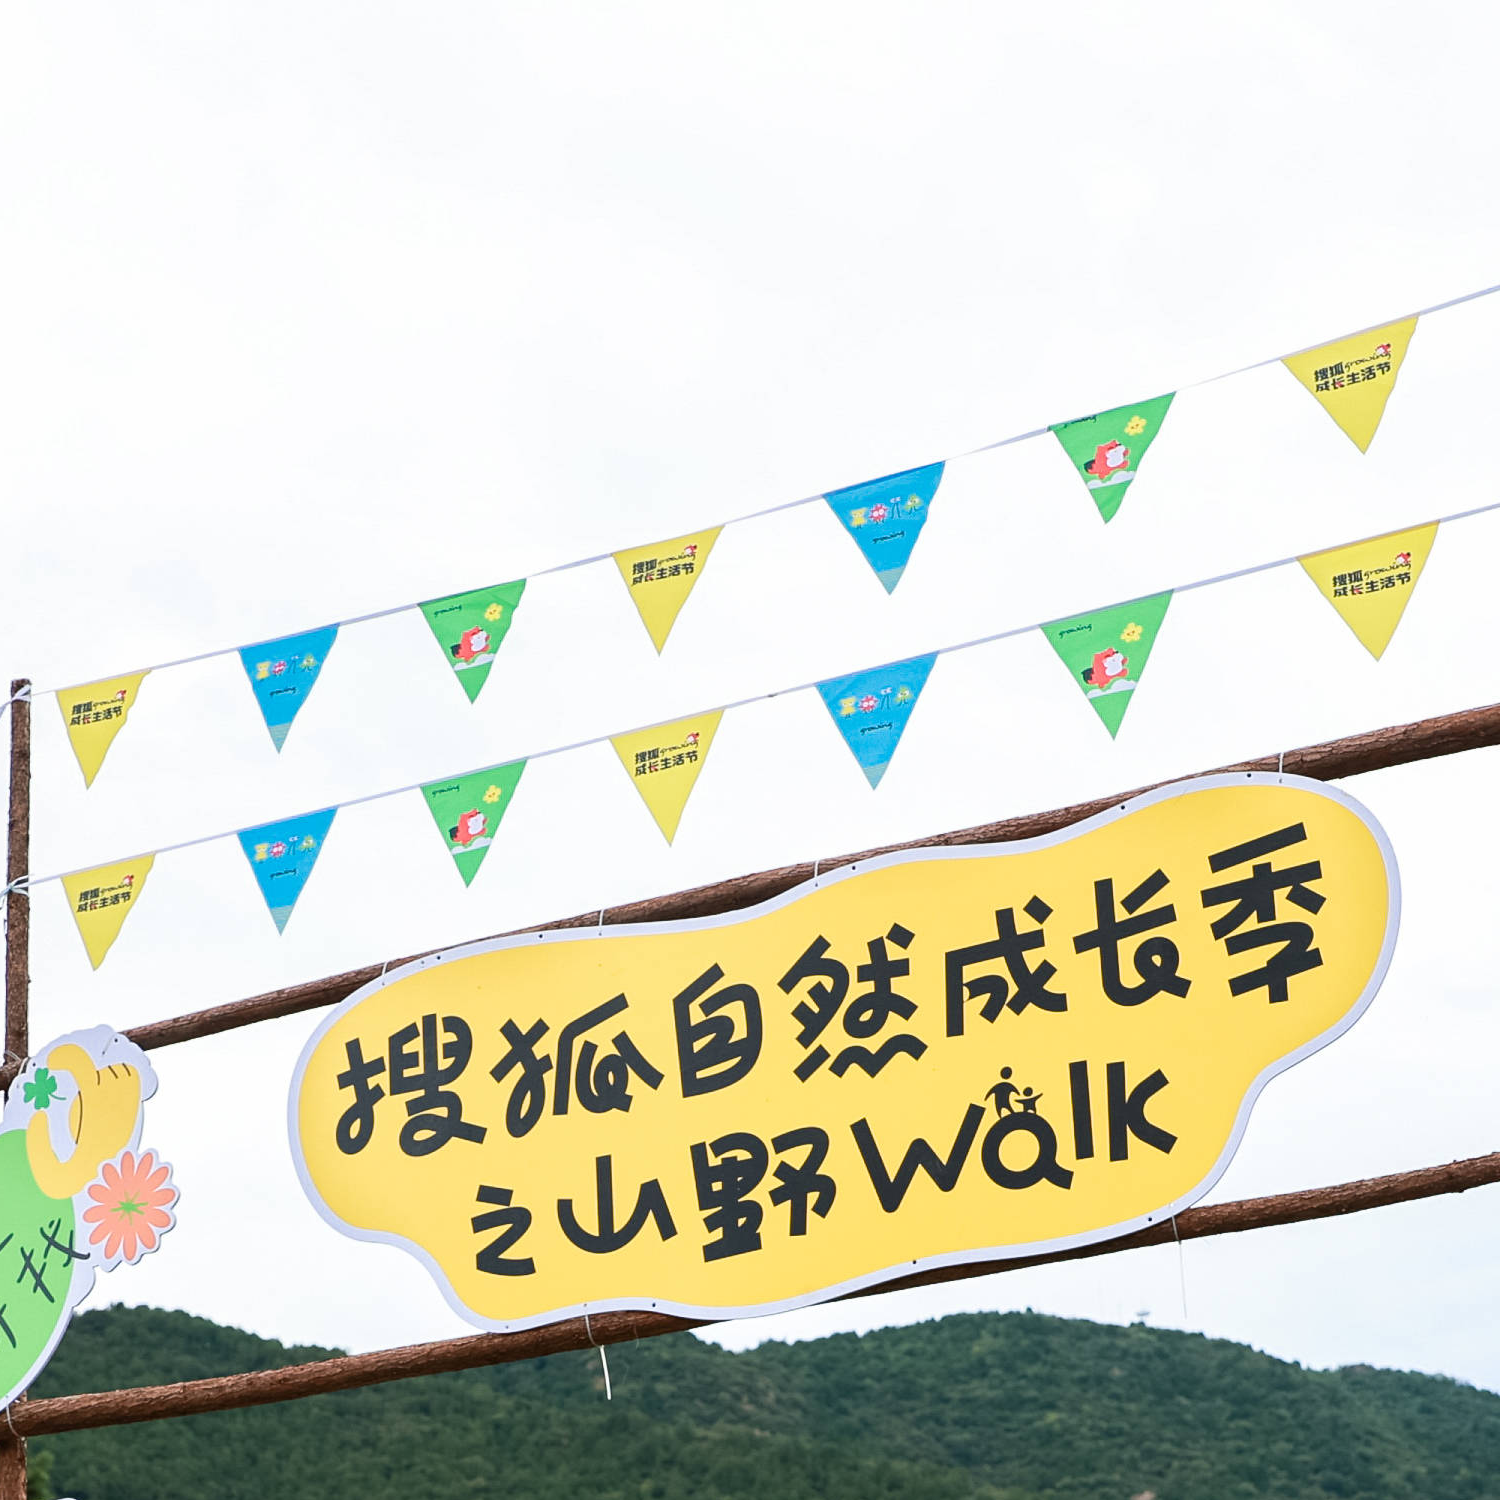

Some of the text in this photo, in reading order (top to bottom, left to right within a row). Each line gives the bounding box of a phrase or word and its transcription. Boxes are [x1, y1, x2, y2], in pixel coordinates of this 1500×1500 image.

[1315, 361, 1391, 392] 成长生活节
[1333, 571, 1411, 598] 成长生活节
[336, 823, 1328, 1158] 搜狐自然成长季
